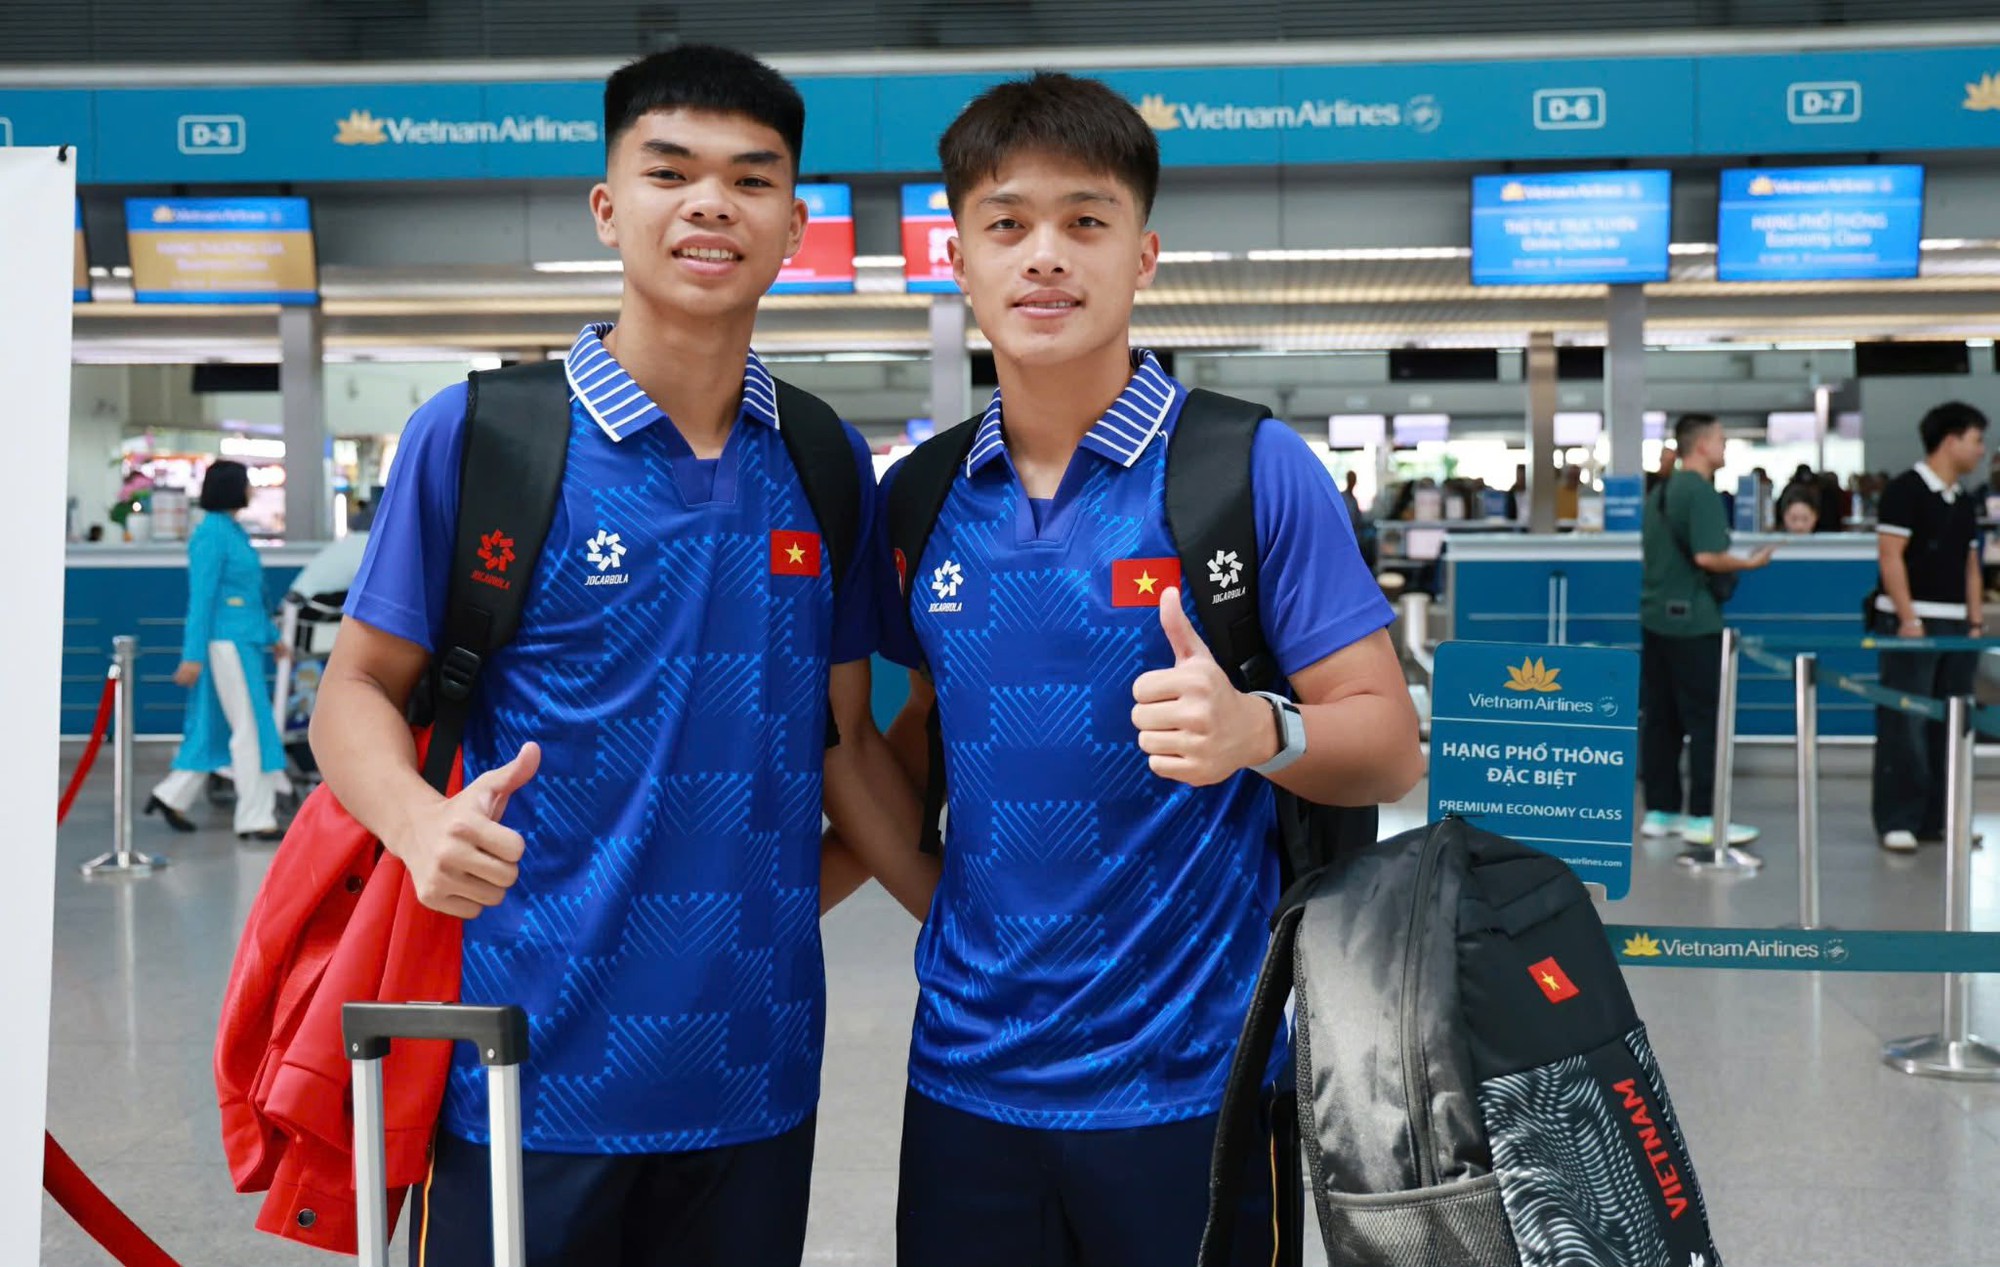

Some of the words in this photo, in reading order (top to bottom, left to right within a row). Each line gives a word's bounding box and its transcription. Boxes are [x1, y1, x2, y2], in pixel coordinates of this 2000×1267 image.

[1548, 97, 1592, 121] D-6
[1802, 91, 1847, 114] D-7
[1179, 102, 1294, 130] Vietnam
[1295, 100, 1401, 126] Airlines
[192, 123, 232, 146] D-3
[386, 117, 499, 144] Vietnam
[499, 115, 598, 142] Airlines
[584, 574, 629, 586] JOGARBOLA
[1469, 693, 1533, 710] Vietnam
[1534, 697, 1593, 713] Airlines
[1442, 742, 1500, 761] HẠNG
[1505, 742, 1548, 762] PHỔ
[1552, 746, 1624, 766] THÔNG
[1487, 765, 1529, 787] ĐẶC
[1534, 769, 1577, 790] BIỆT
[1438, 800, 1503, 814] PREMIUM
[1506, 804, 1576, 818] ECONOMY
[1579, 808, 1623, 821] CLASS
[1662, 939, 1748, 957] Vietnam
[1745, 939, 1820, 958] Airlines
[1612, 1078, 1688, 1220] VIETNAM
